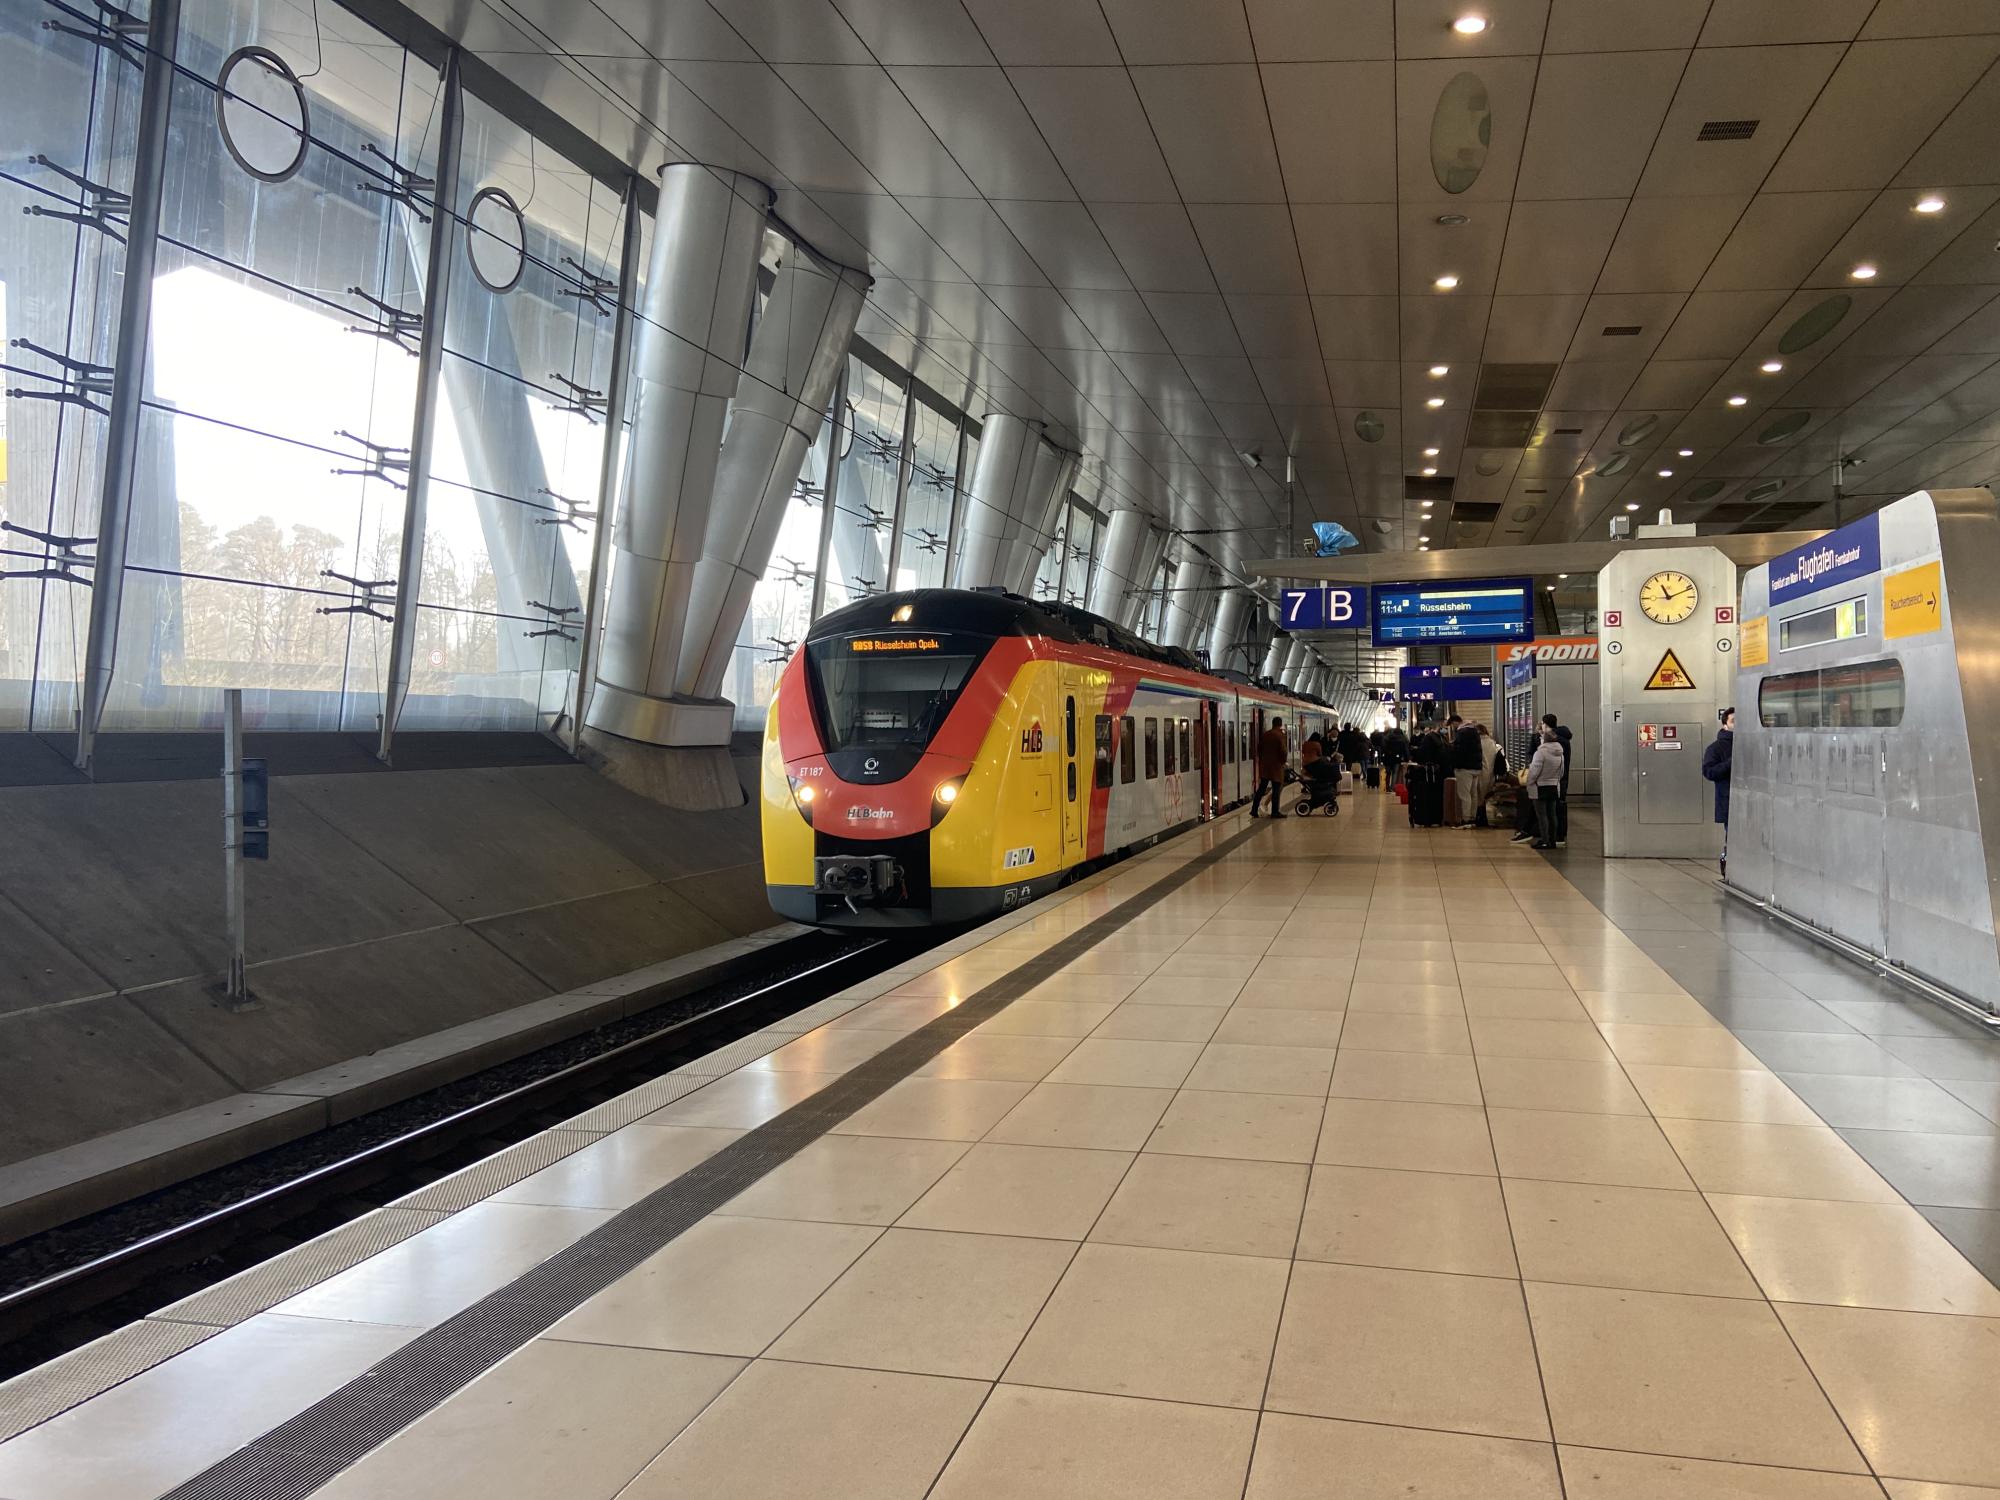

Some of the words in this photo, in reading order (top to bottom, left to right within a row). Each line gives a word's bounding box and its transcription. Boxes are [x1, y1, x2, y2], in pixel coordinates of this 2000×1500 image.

[1798, 546, 1834, 583] Flughafen
[1287, 592, 1306, 621] 7
[1330, 590, 1353, 621] B
[1380, 604, 1402, 614] 11:14
[1420, 602, 1471, 612] Rüsselsheim
[1614, 710, 1621, 722] F
[1021, 729, 1043, 753] HLB
[800, 768, 810, 777] ET
[810, 767, 823, 777] 187
